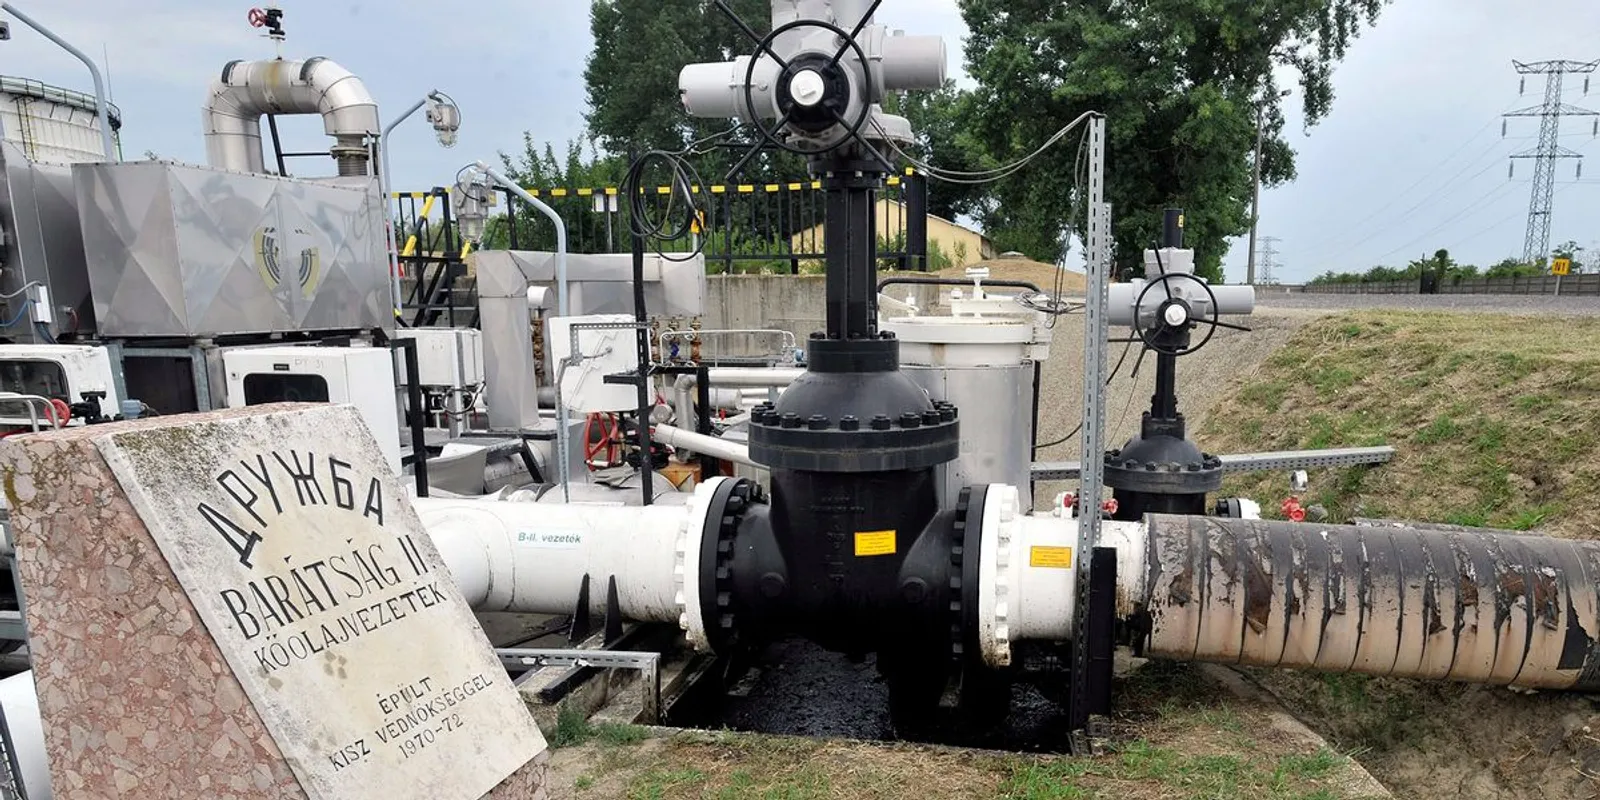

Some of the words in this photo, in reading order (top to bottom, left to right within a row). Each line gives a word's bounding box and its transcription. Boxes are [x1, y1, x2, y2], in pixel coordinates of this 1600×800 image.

[197, 450, 383, 569] ДРУЖБА
[542, 533, 581, 543] vezeték
[220, 538, 401, 640] BARÁTSÁG
[329, 739, 371, 772] KISZ
[375, 674, 493, 744] VÉDNÖKSÉGGEL
[376, 676, 432, 715] ÉPÜLT
[398, 713, 464, 759] 1970-72
